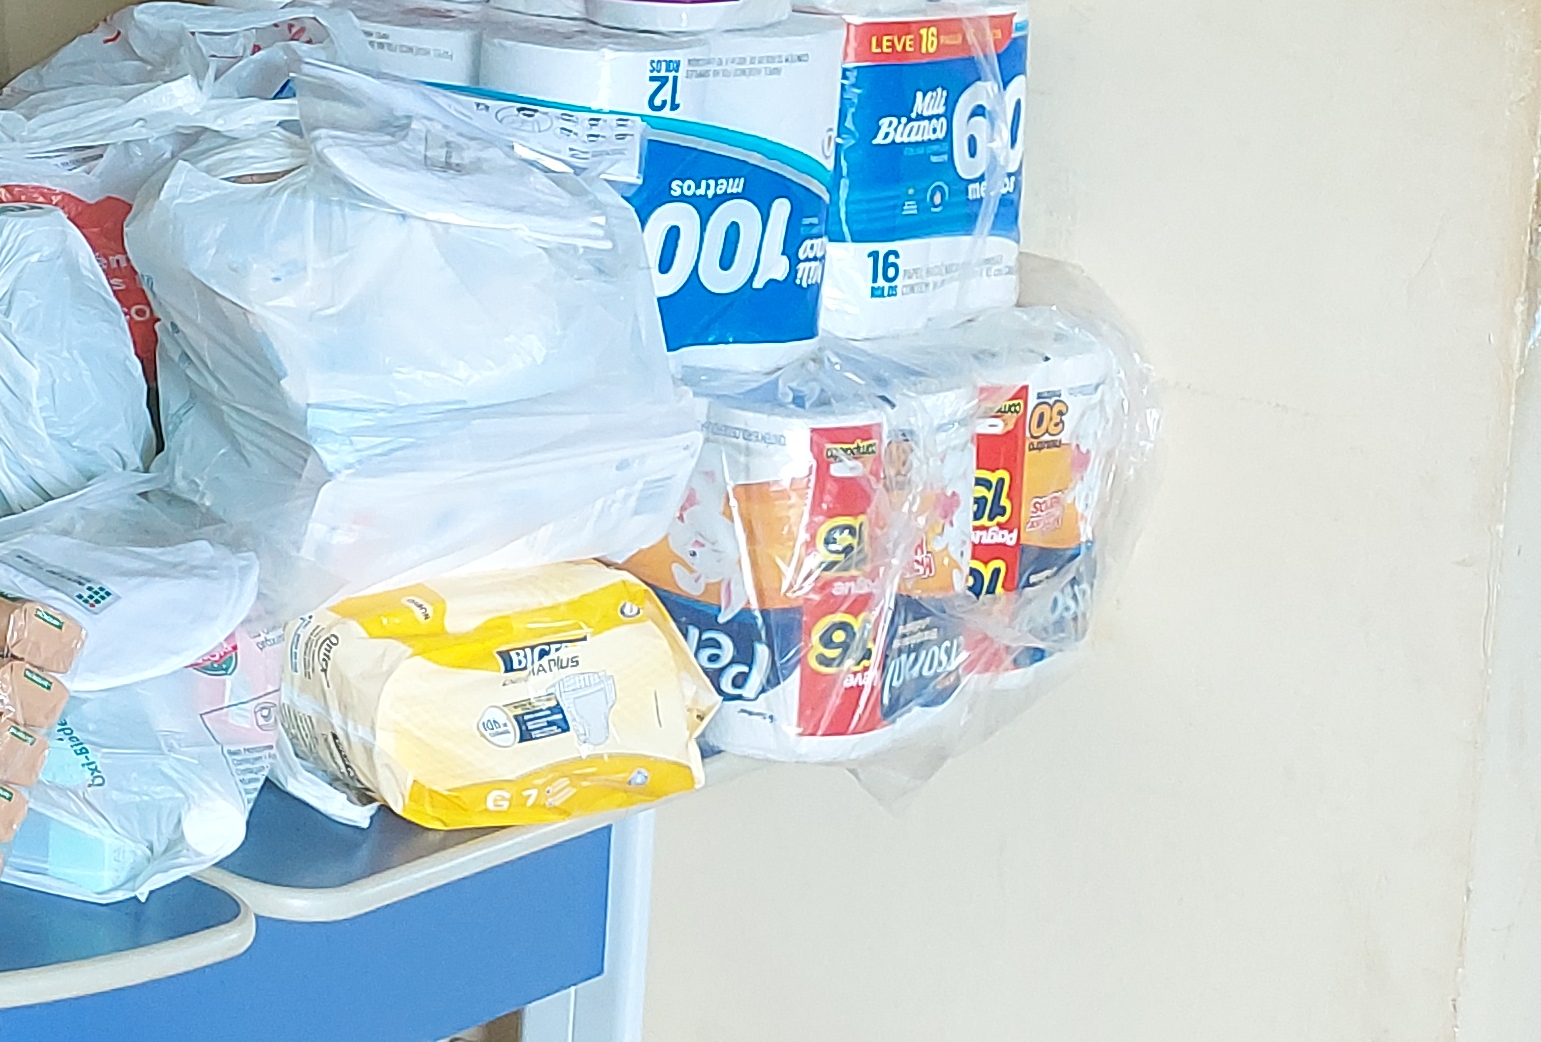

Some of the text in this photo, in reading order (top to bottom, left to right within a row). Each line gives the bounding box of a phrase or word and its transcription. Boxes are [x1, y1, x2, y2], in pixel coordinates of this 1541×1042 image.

[871, 35, 915, 53] LEVE
[919, 27, 938, 53] 16
[649, 59, 680, 74] ROLOS
[648, 74, 681, 113] 12
[910, 85, 948, 119] Mili
[871, 115, 948, 146] Bianco
[952, 74, 1027, 181] 60
[670, 176, 745, 199] metros
[642, 197, 792, 298] 100
[867, 249, 901, 284] 16
[1028, 399, 1070, 439] 30
[486, 788, 539, 812] G 7
